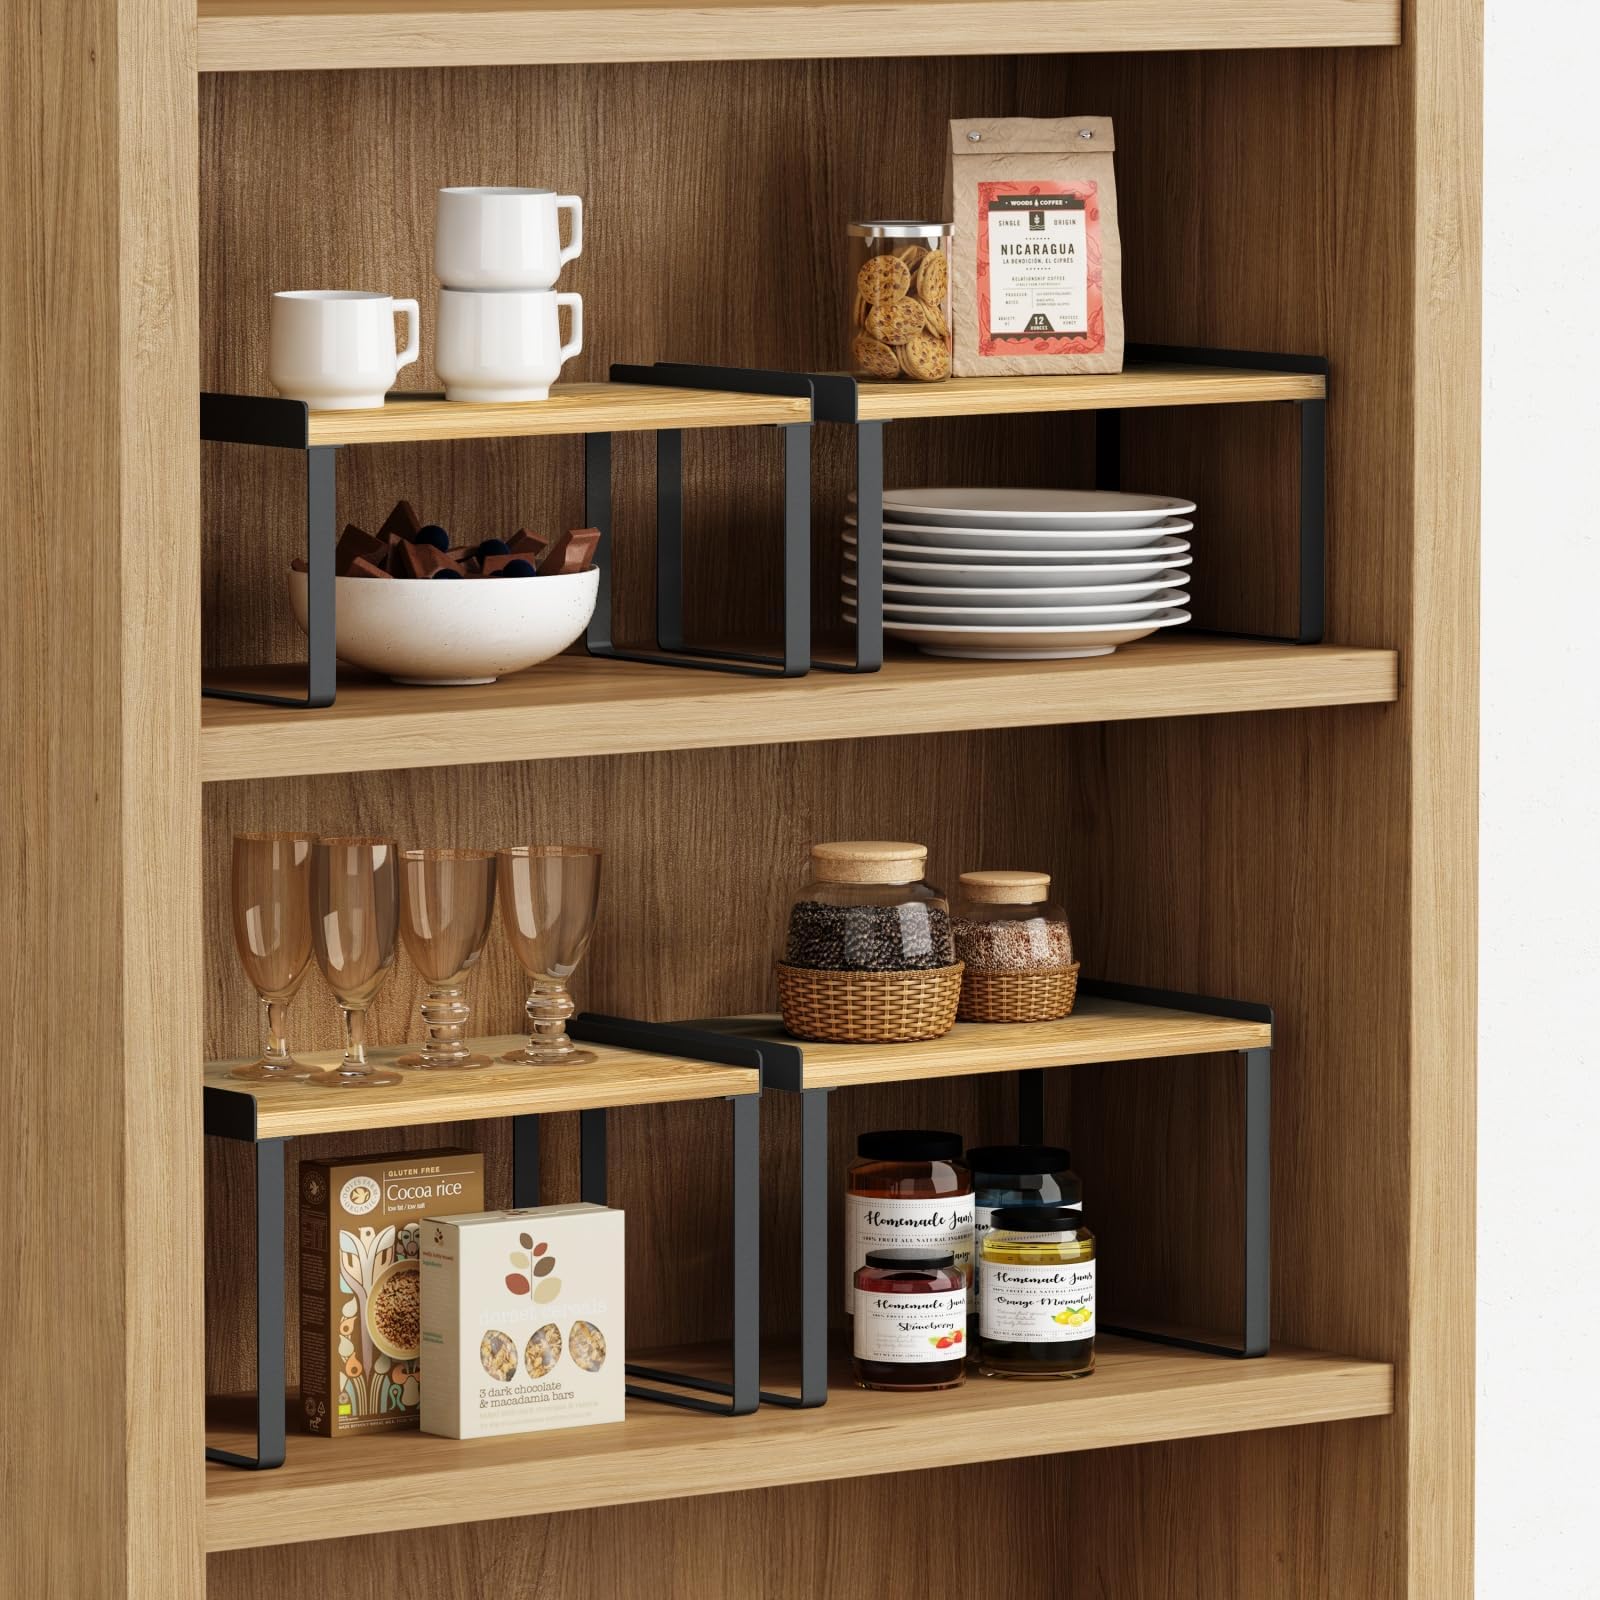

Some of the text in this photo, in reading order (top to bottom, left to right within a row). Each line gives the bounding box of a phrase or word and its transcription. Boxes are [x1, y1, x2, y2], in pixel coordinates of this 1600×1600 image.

[1001, 243, 1075, 255] NICARAGUA
[1034, 316, 1045, 325] 12
[388, 1166, 440, 1177] GLUTEN FREE
[387, 1180, 462, 1201] Cocoa rice
[864, 1210, 973, 1230] Homemade Jams
[993, 1271, 1093, 1285] Homemade Jams
[873, 1298, 943, 1309] Homemade
[995, 1296, 1034, 1308] Orange
[897, 1321, 954, 1332] Strawberry
[479, 1382, 562, 1398] 3 dark chocolate
[479, 1390, 575, 1408] & macadamia bars
